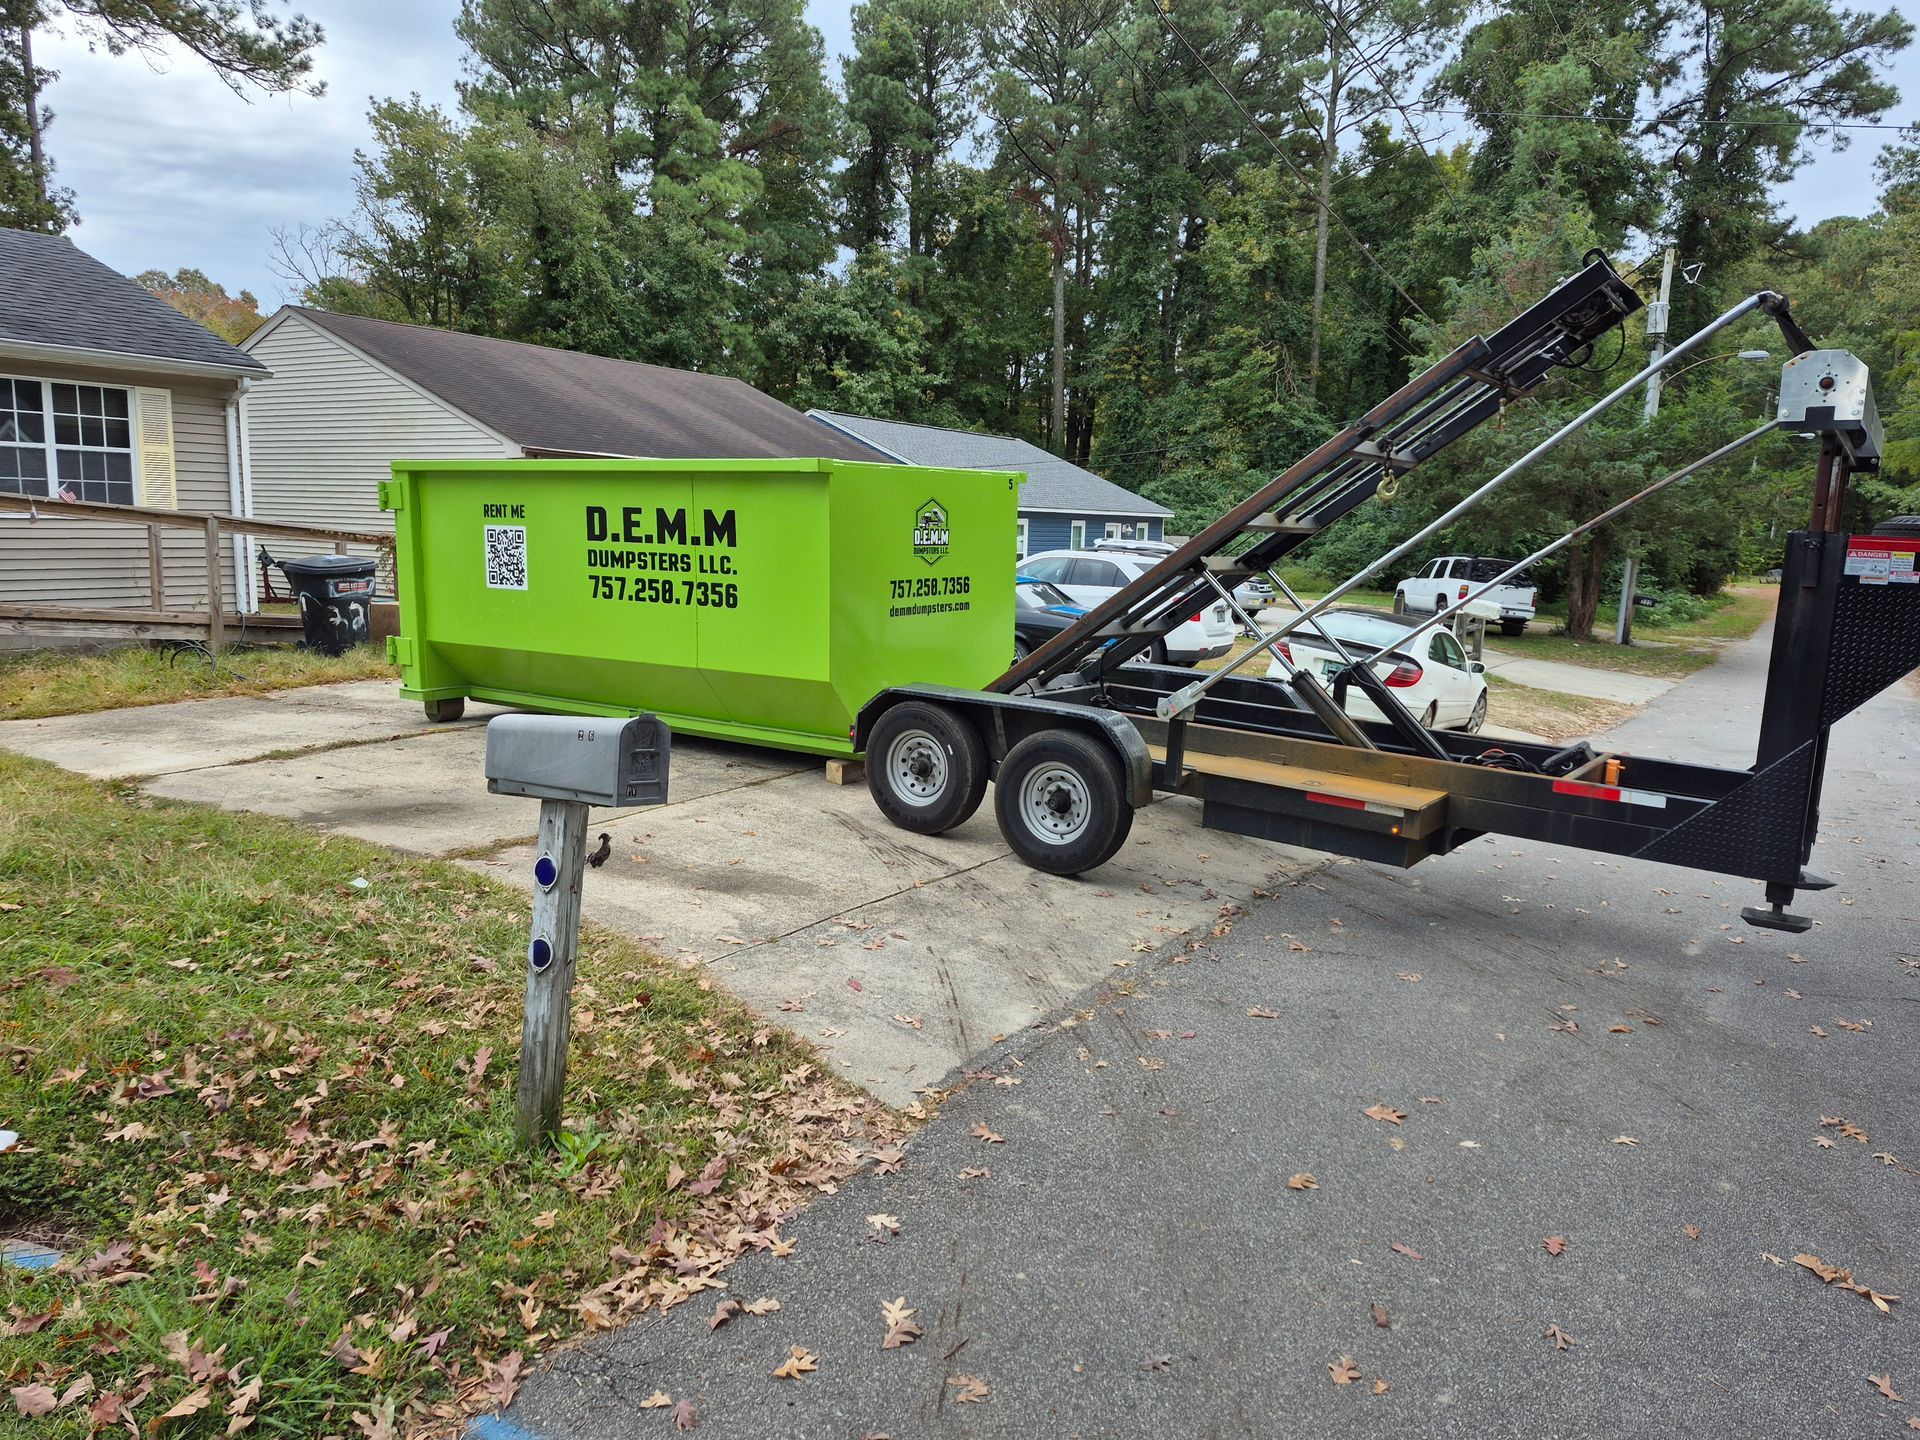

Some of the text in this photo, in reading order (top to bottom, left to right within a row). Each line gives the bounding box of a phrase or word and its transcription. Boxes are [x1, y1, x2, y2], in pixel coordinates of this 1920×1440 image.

[484, 504, 525, 518] RENT ME
[586, 506, 737, 547] D.E.M.M
[914, 529, 949, 545] D.E.M.M
[913, 547, 940, 555] DUMPSTERS
[587, 549, 738, 575] DUMPSTERS LLC.
[890, 602, 970, 617] demmdumpsters.com
